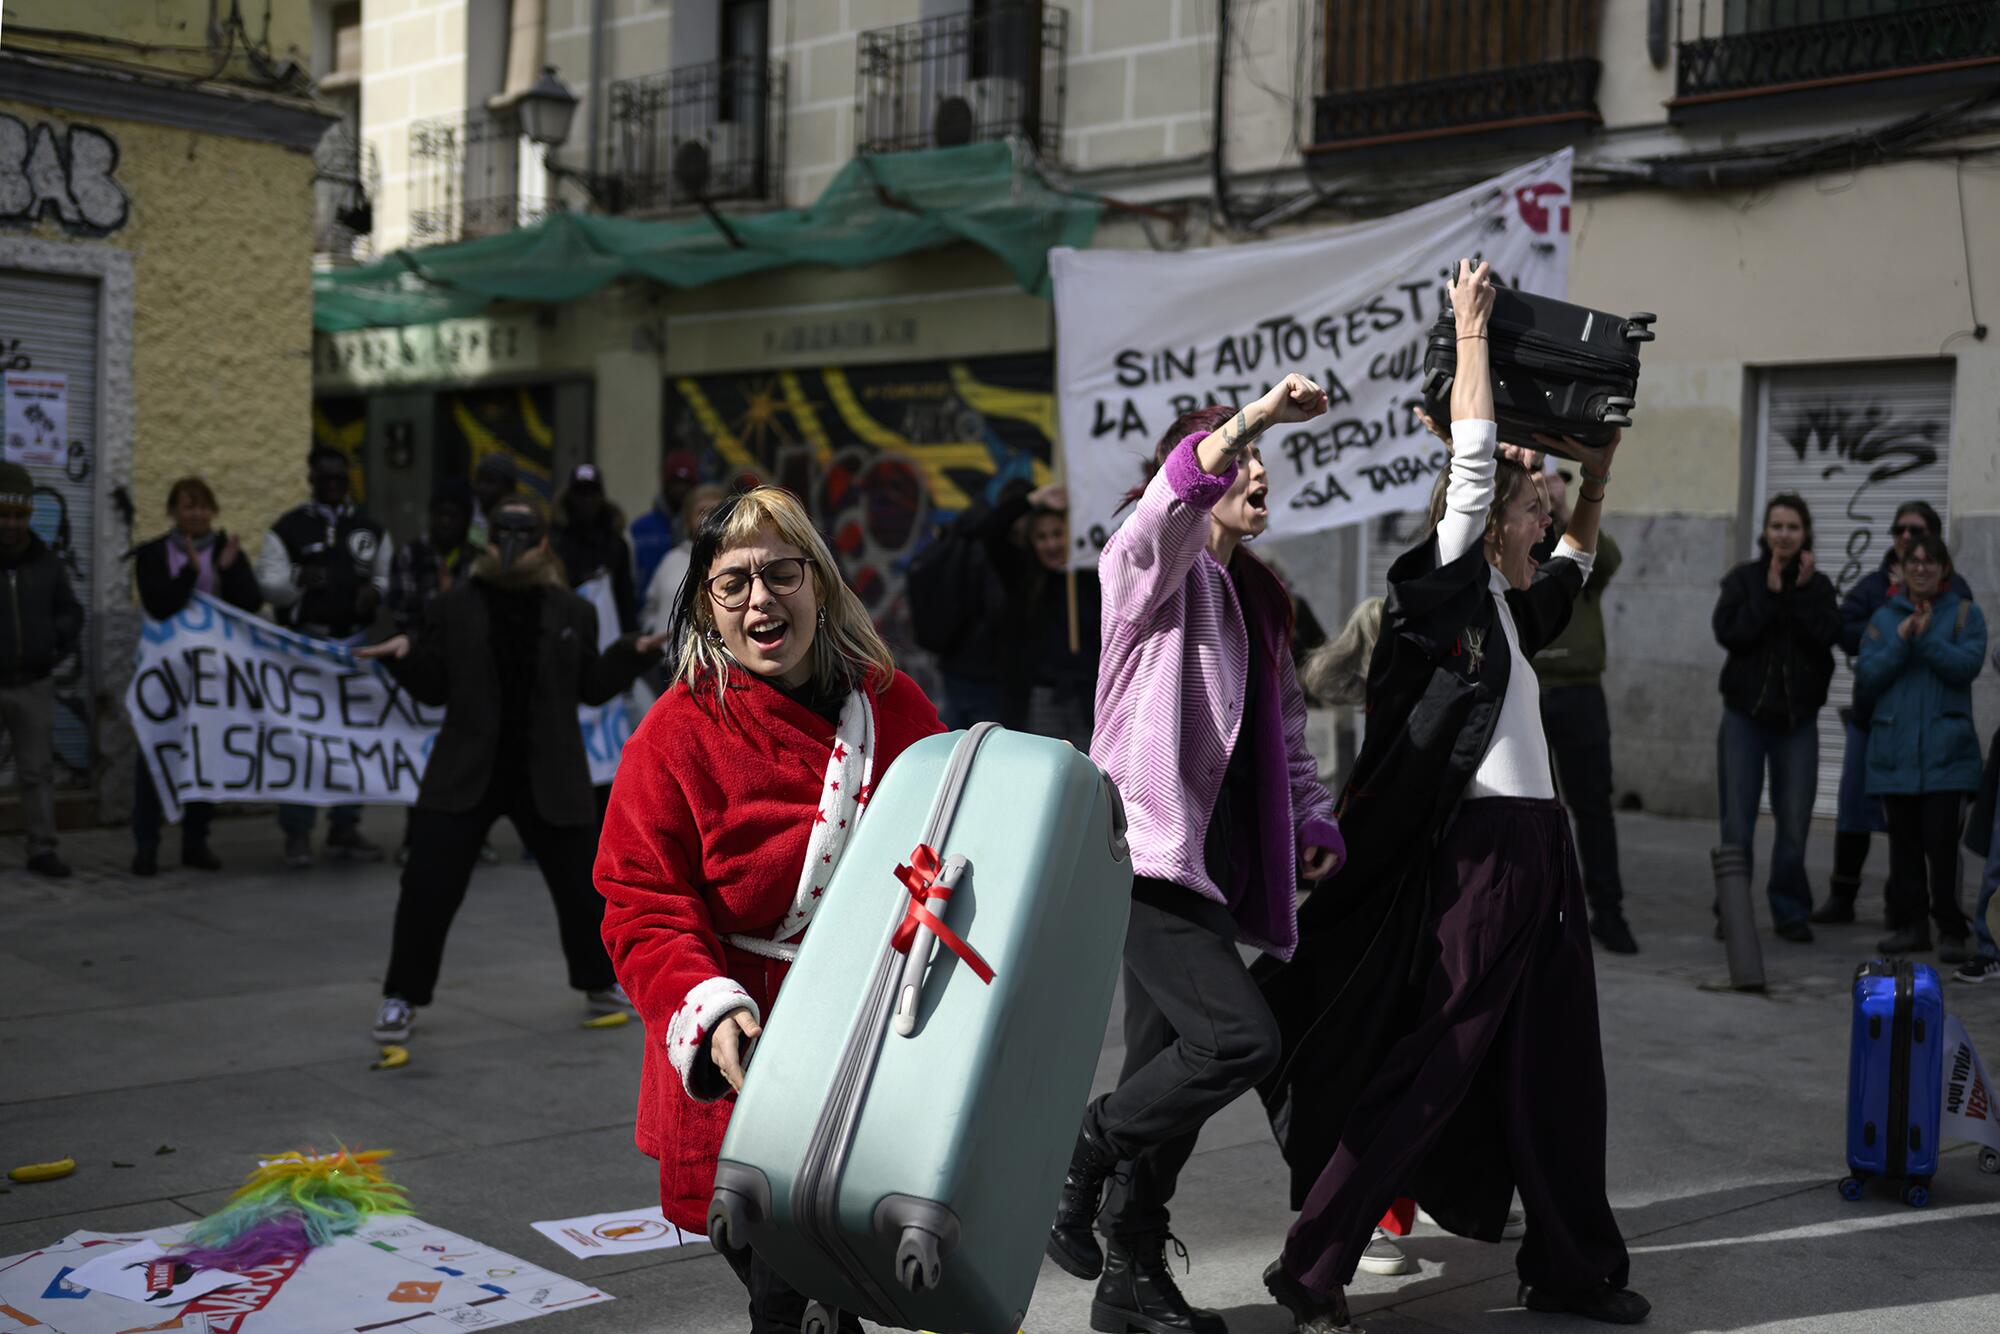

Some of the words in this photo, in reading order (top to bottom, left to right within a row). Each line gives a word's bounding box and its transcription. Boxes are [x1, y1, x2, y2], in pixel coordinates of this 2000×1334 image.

[1114, 346, 1197, 388] SIN
[1213, 252, 1519, 376] AUTOGESTI
[1091, 399, 1149, 440] LA
[1366, 339, 1425, 383] CUL
[1281, 397, 1429, 477] PERDID
[1356, 450, 1446, 494] TABAC
[224, 653, 326, 723] NOS
[222, 722, 422, 796] SISTEMA
